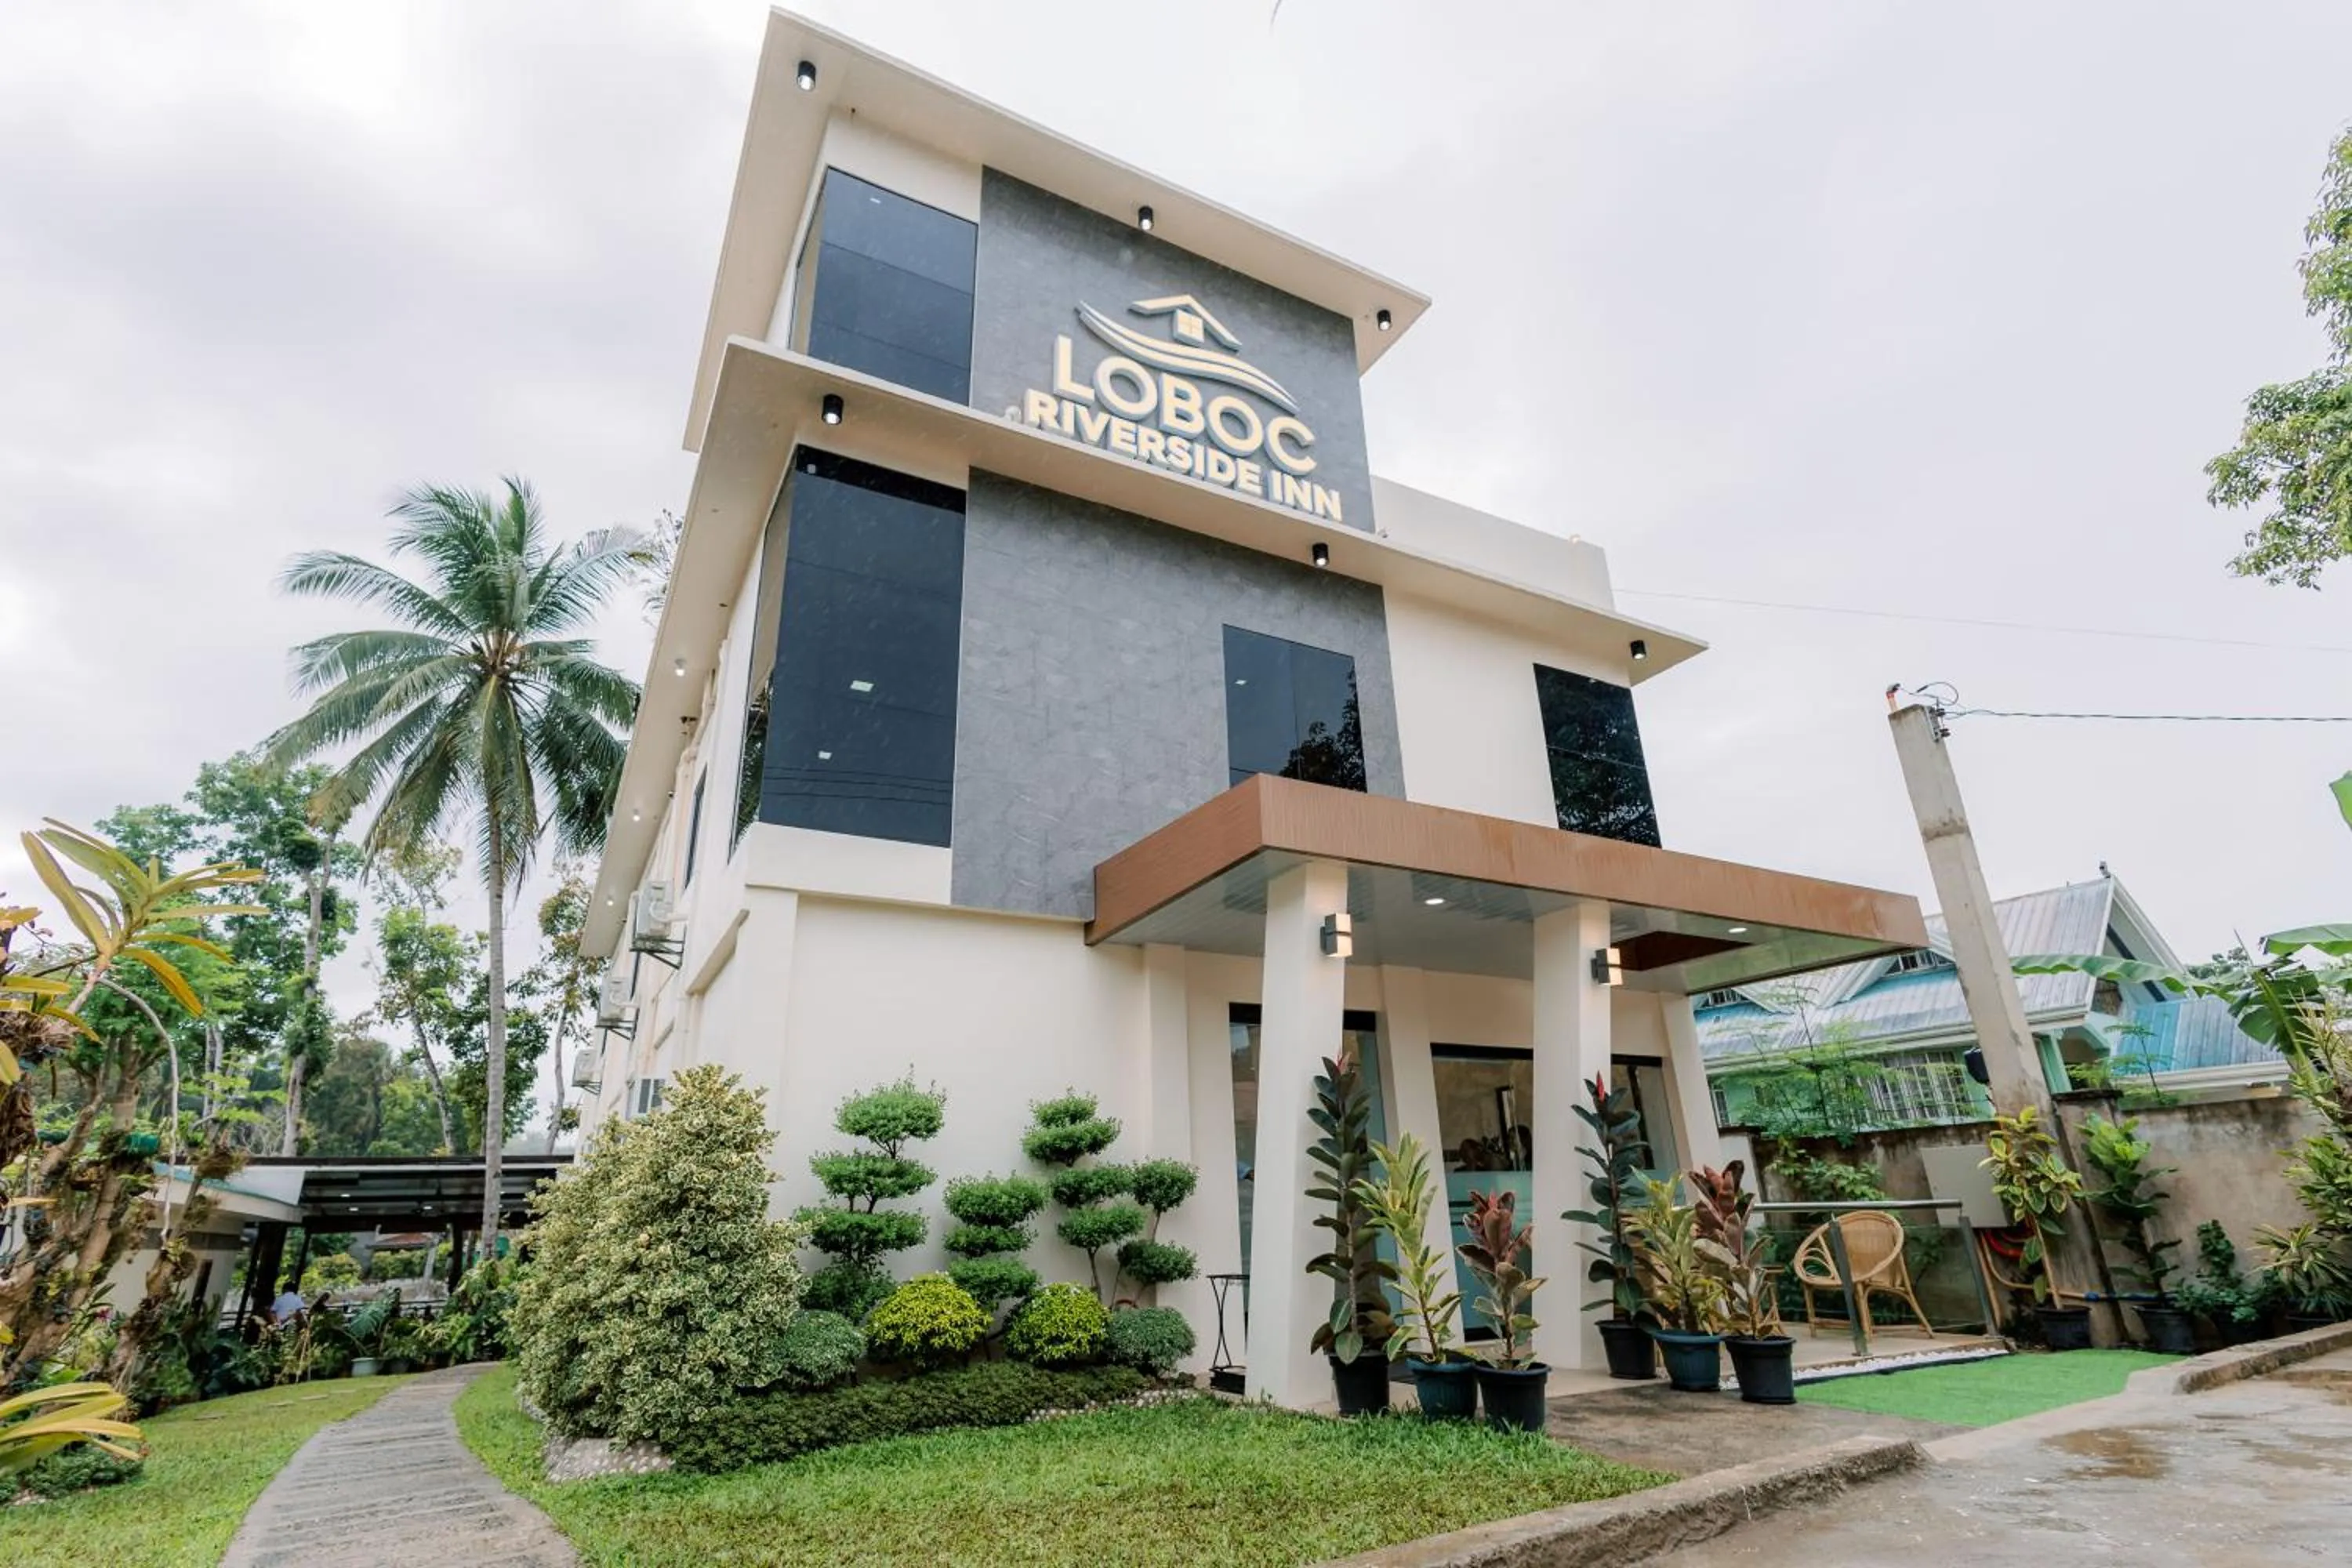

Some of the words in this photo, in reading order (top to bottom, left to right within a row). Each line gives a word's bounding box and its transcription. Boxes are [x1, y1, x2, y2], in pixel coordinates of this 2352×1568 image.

[1025, 388, 1263, 495] RIVERSIDE
[1268, 470, 1342, 521] INN
[1054, 335, 1317, 476] LOBOC
